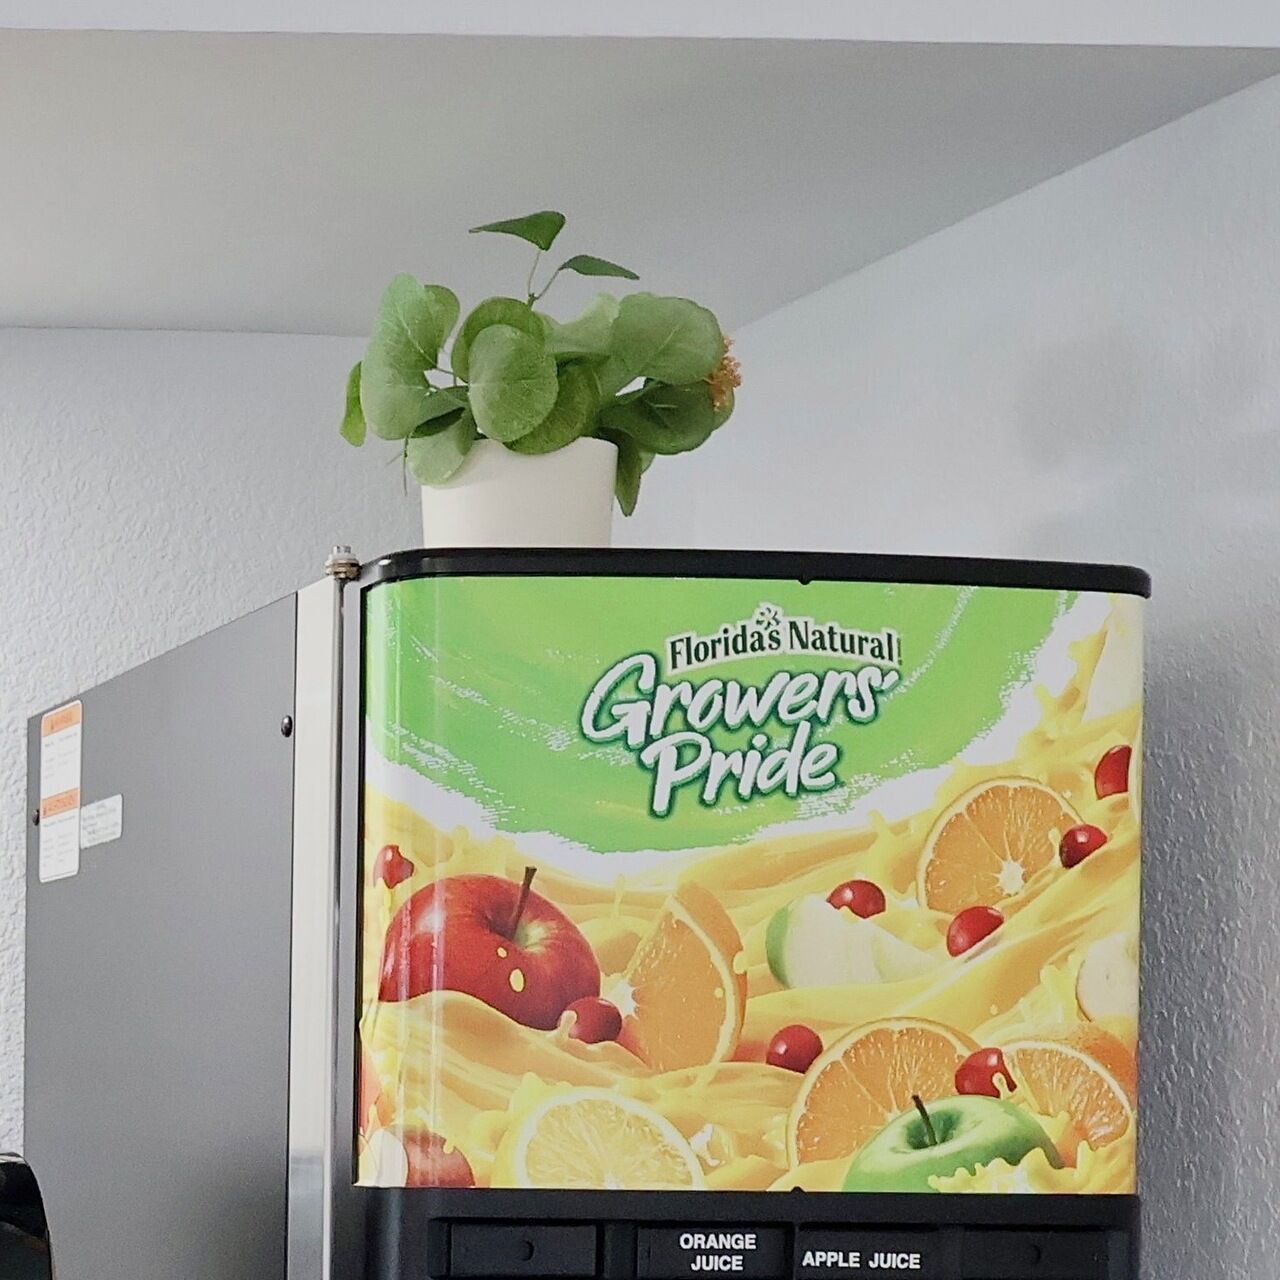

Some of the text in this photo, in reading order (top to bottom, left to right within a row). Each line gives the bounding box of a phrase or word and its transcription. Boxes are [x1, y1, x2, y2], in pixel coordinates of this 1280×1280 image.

[670, 622, 781, 670] Florida's
[789, 620, 894, 663] Natural
[640, 720, 838, 814] Pride
[679, 1233, 757, 1250] ORANGE
[690, 1255, 744, 1271] JUICE
[802, 1251, 921, 1269] APPLE JUICE
